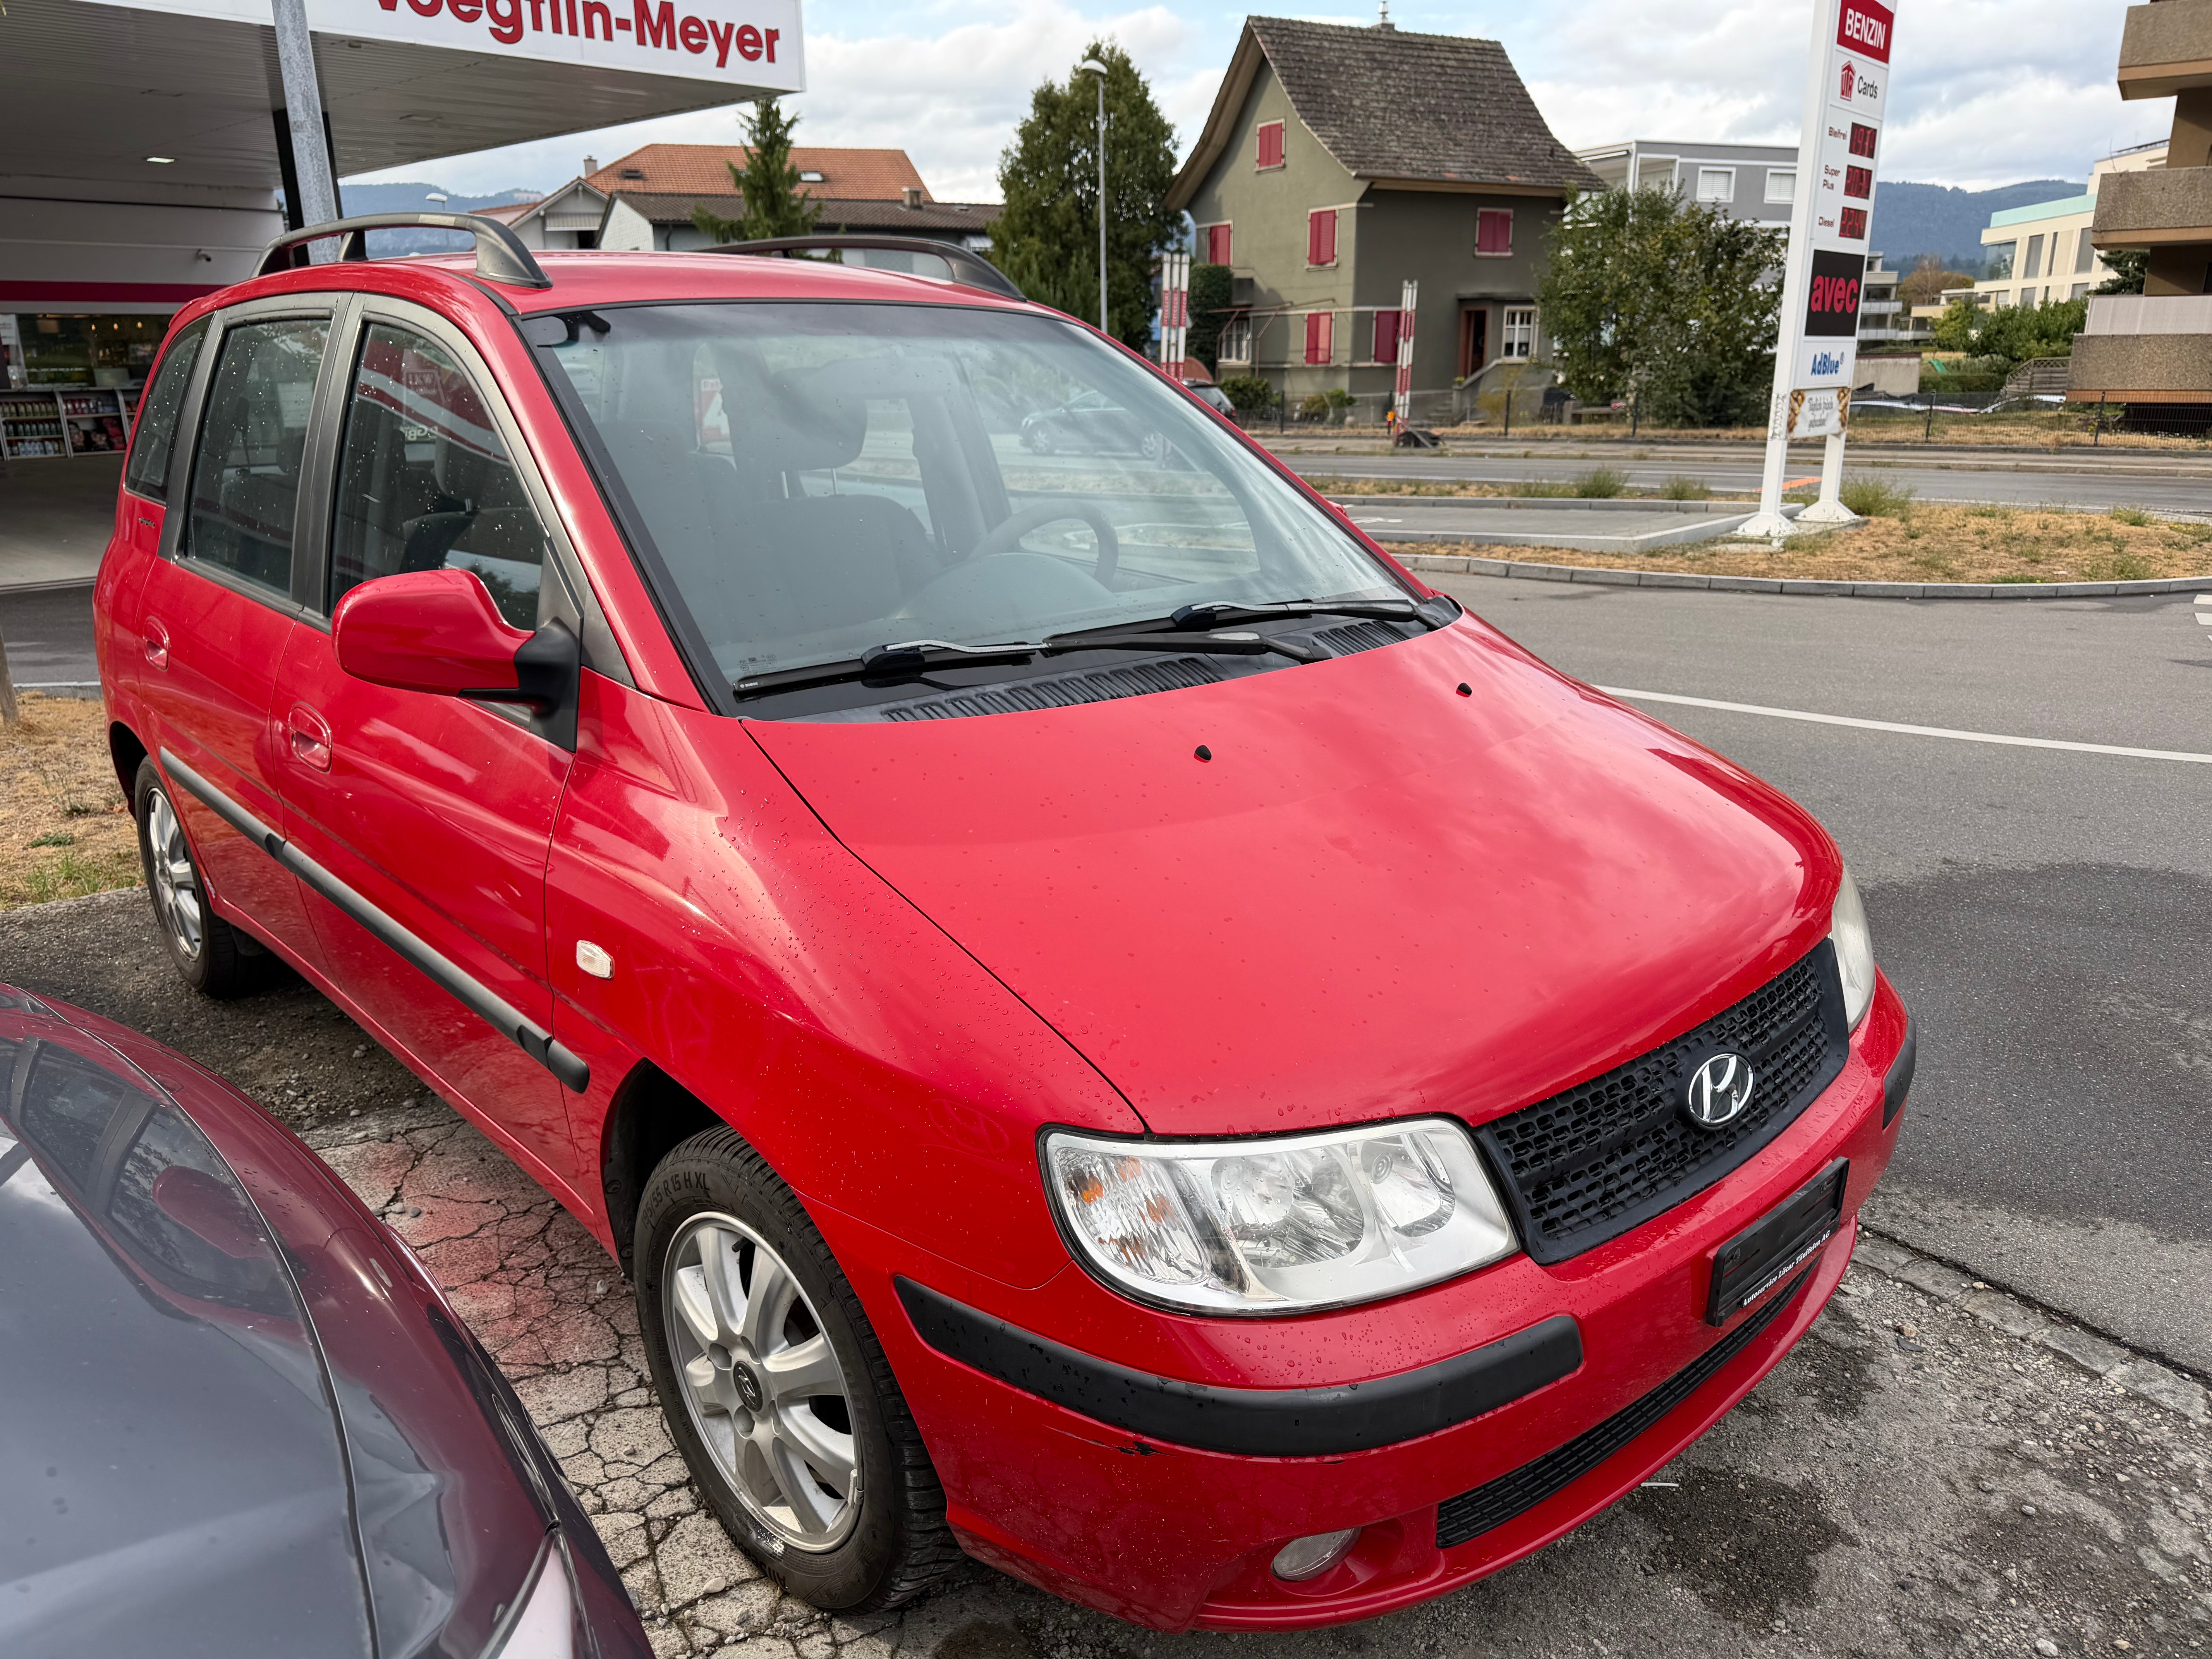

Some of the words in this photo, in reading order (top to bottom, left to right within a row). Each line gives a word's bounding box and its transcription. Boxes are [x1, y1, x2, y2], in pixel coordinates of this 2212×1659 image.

[1845, 8, 1886, 50] BENZIN
[1858, 76, 1878, 99] Cards
[1825, 164, 1840, 177] Super
[1811, 275, 1858, 314] avec
[641, 1185, 663, 1229] 195/55
[663, 1179, 672, 1197] R
[670, 1173, 682, 1192] 15
[684, 1171, 692, 1188] H
[694, 1171, 710, 1191] XL
[1743, 1276, 1777, 1306] Autoservice
[1821, 1230, 1830, 1242] AG
